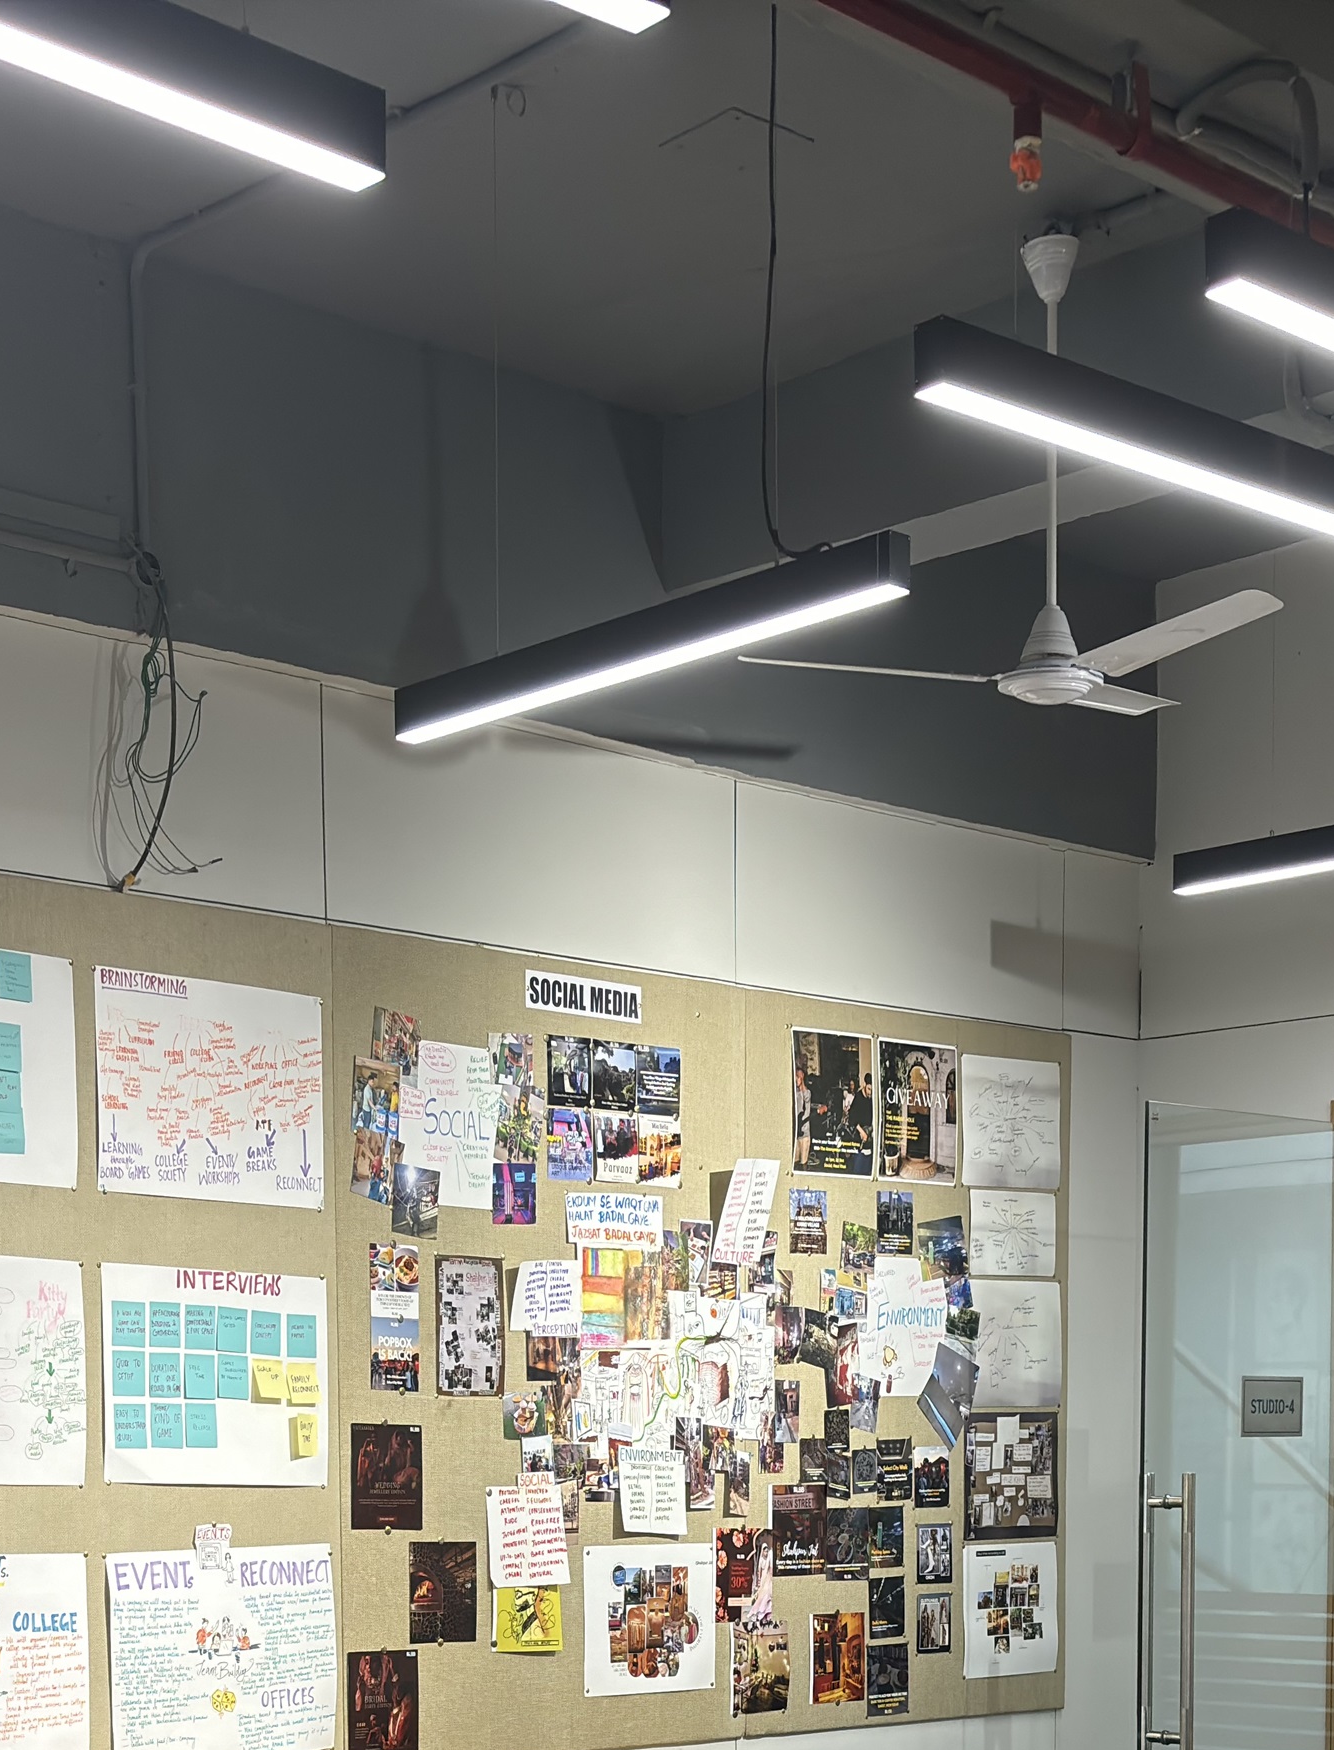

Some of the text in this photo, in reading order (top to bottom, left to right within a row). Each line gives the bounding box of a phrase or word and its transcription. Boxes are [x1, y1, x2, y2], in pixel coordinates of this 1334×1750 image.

[100, 967, 188, 997] BRAINSTORMING
[529, 976, 639, 1019] SOCIAL MEDIA
[886, 1086, 950, 1110] GIVEAWAY
[424, 1097, 490, 1141] SOCIAL
[102, 1142, 143, 1156] LEARNING
[247, 1146, 273, 1159] GAME
[155, 1153, 189, 1167] COLLEGE
[246, 1159, 277, 1172] BREAKS
[100, 1165, 151, 1180] BOARD GAMES
[158, 1168, 187, 1183] SOCIETY
[199, 1172, 241, 1186] WORKSHOPS
[276, 1174, 322, 1192] RECONNECT
[567, 1195, 596, 1208] EKDUM
[600, 1195, 612, 1209] SE
[615, 1196, 643, 1211] WAQT
[569, 1210, 594, 1222] HALAT
[598, 1210, 628, 1224] BADAL
[604, 1228, 633, 1242] BADAL
[714, 1248, 755, 1264] CULTURE
[176, 1269, 282, 1297] INTERVIEWS
[877, 1301, 946, 1331] ENVIRONMENT
[533, 1322, 578, 1336] PERCEPTION
[378, 1335, 412, 1349] POPBOX
[379, 1349, 387, 1360] IS
[1250, 1399, 1295, 1414] STUDIO-4
[619, 1447, 682, 1462] ENVIRONMENT
[520, 1473, 553, 1487] SOCIAL
[773, 1499, 793, 1509] ASHION
[196, 1527, 232, 1541] EVENTS
[240, 1559, 330, 1588] RECONNECT
[12, 1611, 78, 1632] COLLEGE
[261, 1686, 315, 1709] OFFICES
[364, 1694, 388, 1704] BRIDAL
